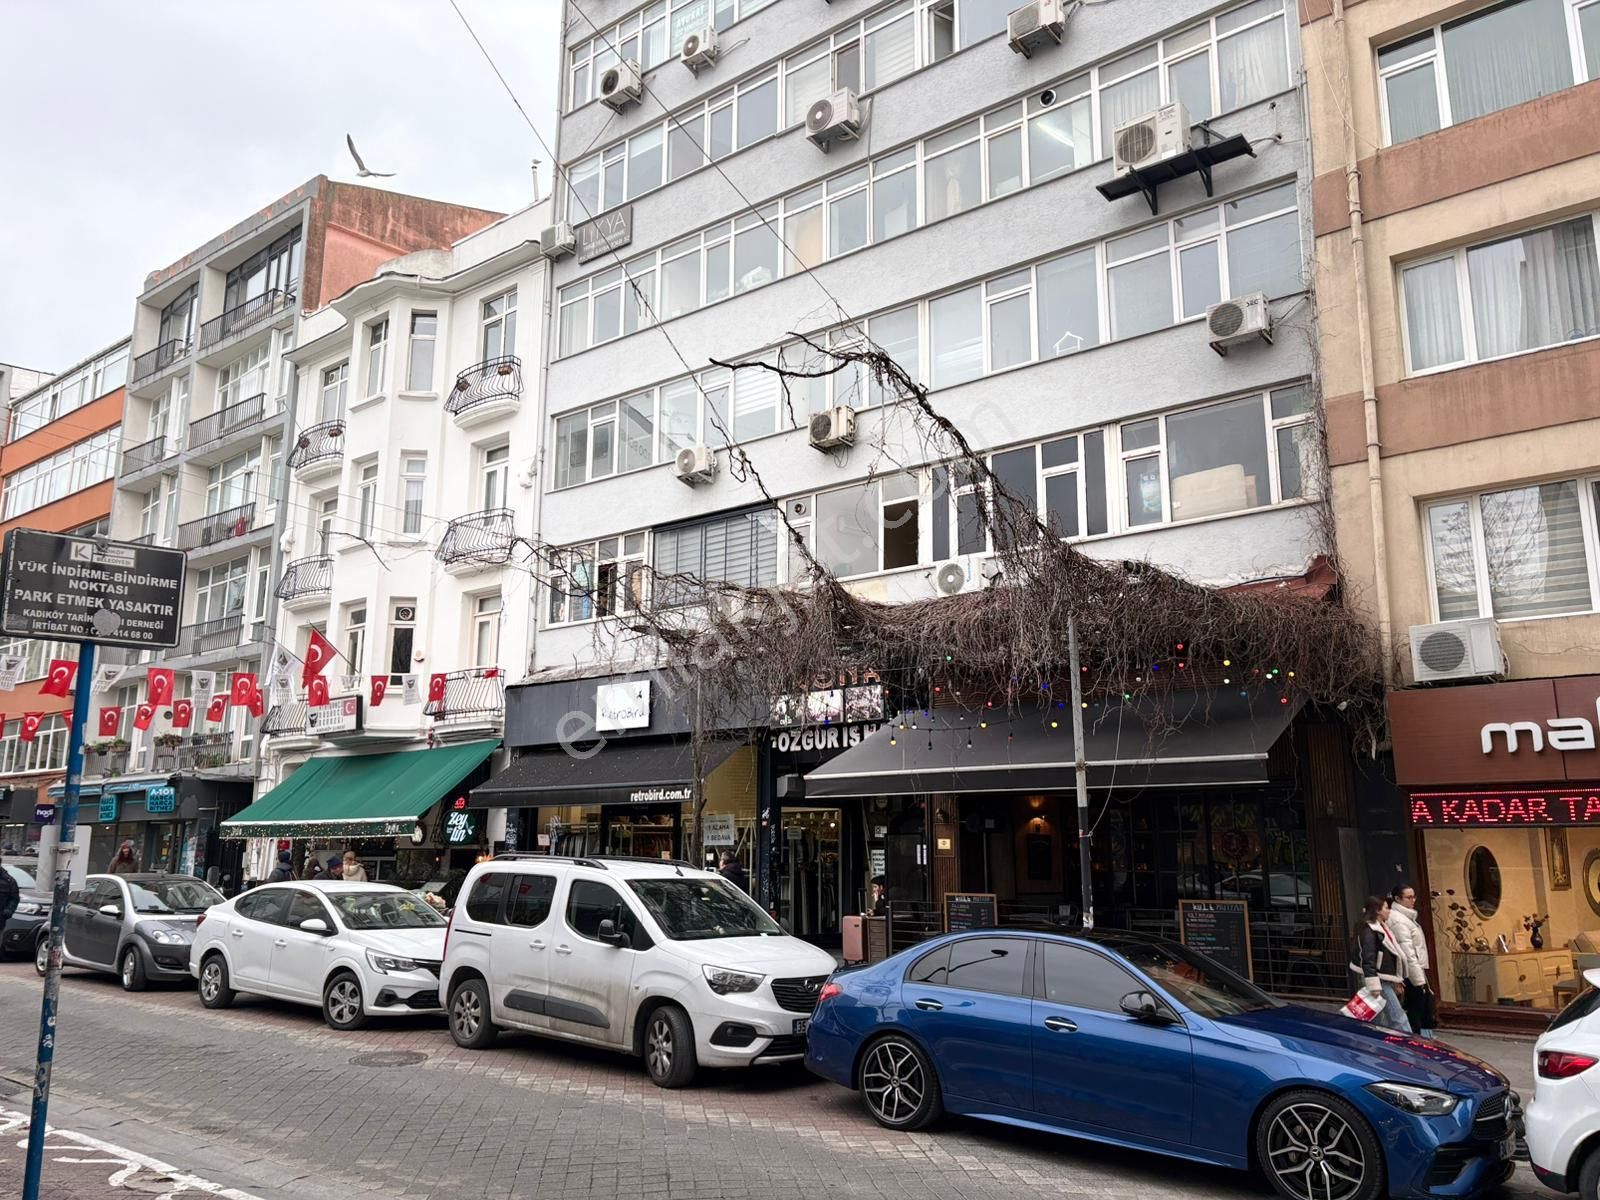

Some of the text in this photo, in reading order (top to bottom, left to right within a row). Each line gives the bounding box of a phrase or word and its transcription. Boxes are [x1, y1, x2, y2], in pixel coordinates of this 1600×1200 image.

[17, 560, 178, 589] YÜK İNDİRME-BİNDİRME
[69, 579, 128, 595] NOKTASI
[14, 589, 174, 616] PARK ETMEK YASAKTIR
[23, 608, 65, 619] KADIKÖY
[67, 612, 94, 622] TARİH
[126, 618, 164, 629] DERNEĞİ
[32, 619, 68, 632] İRTİBAT
[113, 629, 129, 638] 414
[130, 630, 141, 639] 68
[143, 632, 153, 640] 00
[630, 787, 692, 802] retrobird.com.tr
[1441, 798, 1553, 823] KADAR
